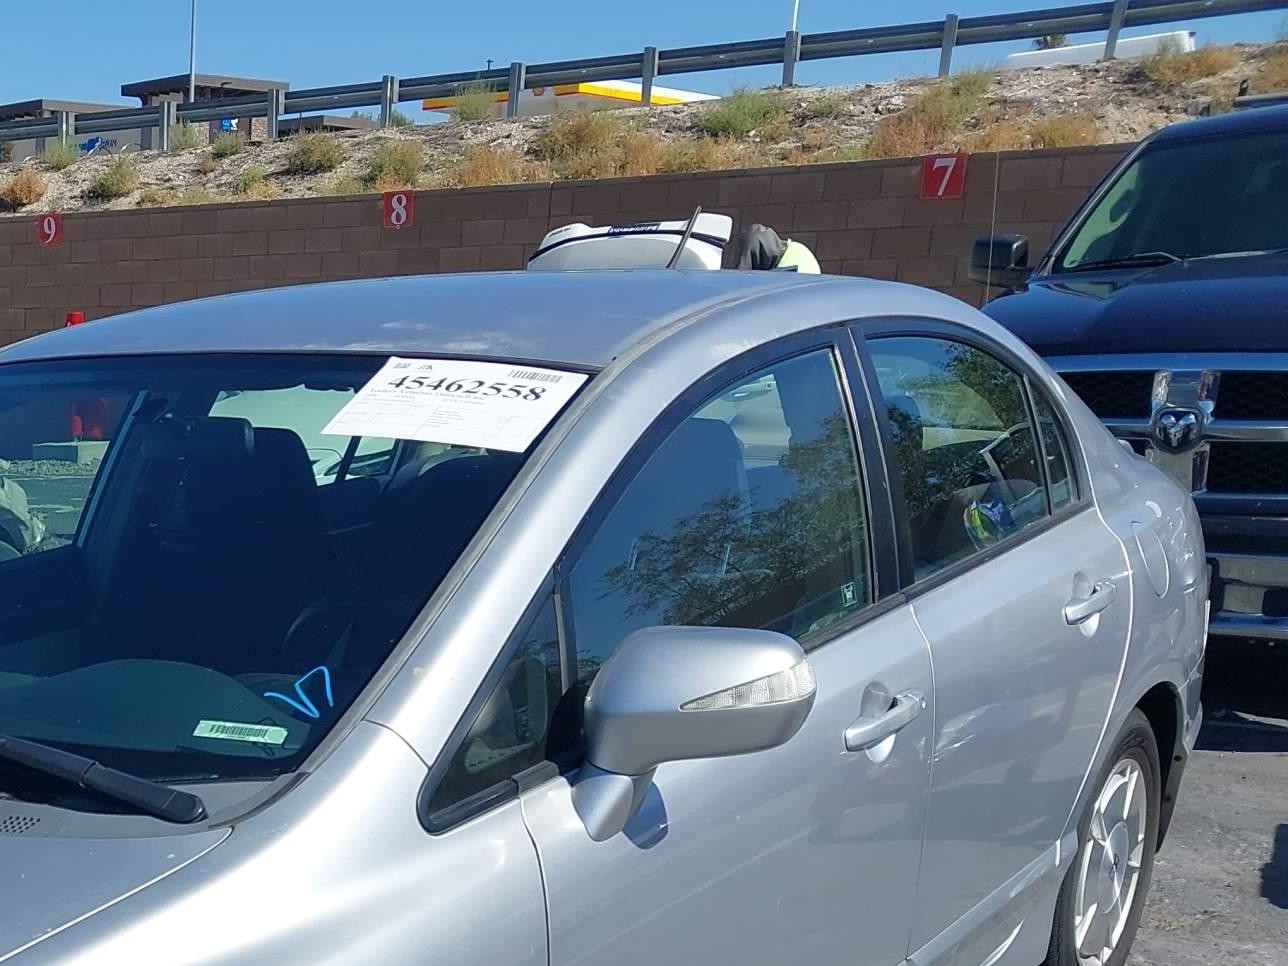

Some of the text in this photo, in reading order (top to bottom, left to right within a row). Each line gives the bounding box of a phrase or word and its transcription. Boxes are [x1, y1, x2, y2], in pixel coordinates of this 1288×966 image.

[933, 158, 957, 196] 7
[391, 194, 407, 225] 8
[43, 216, 56, 243] 9
[388, 375, 547, 401] 45462558
